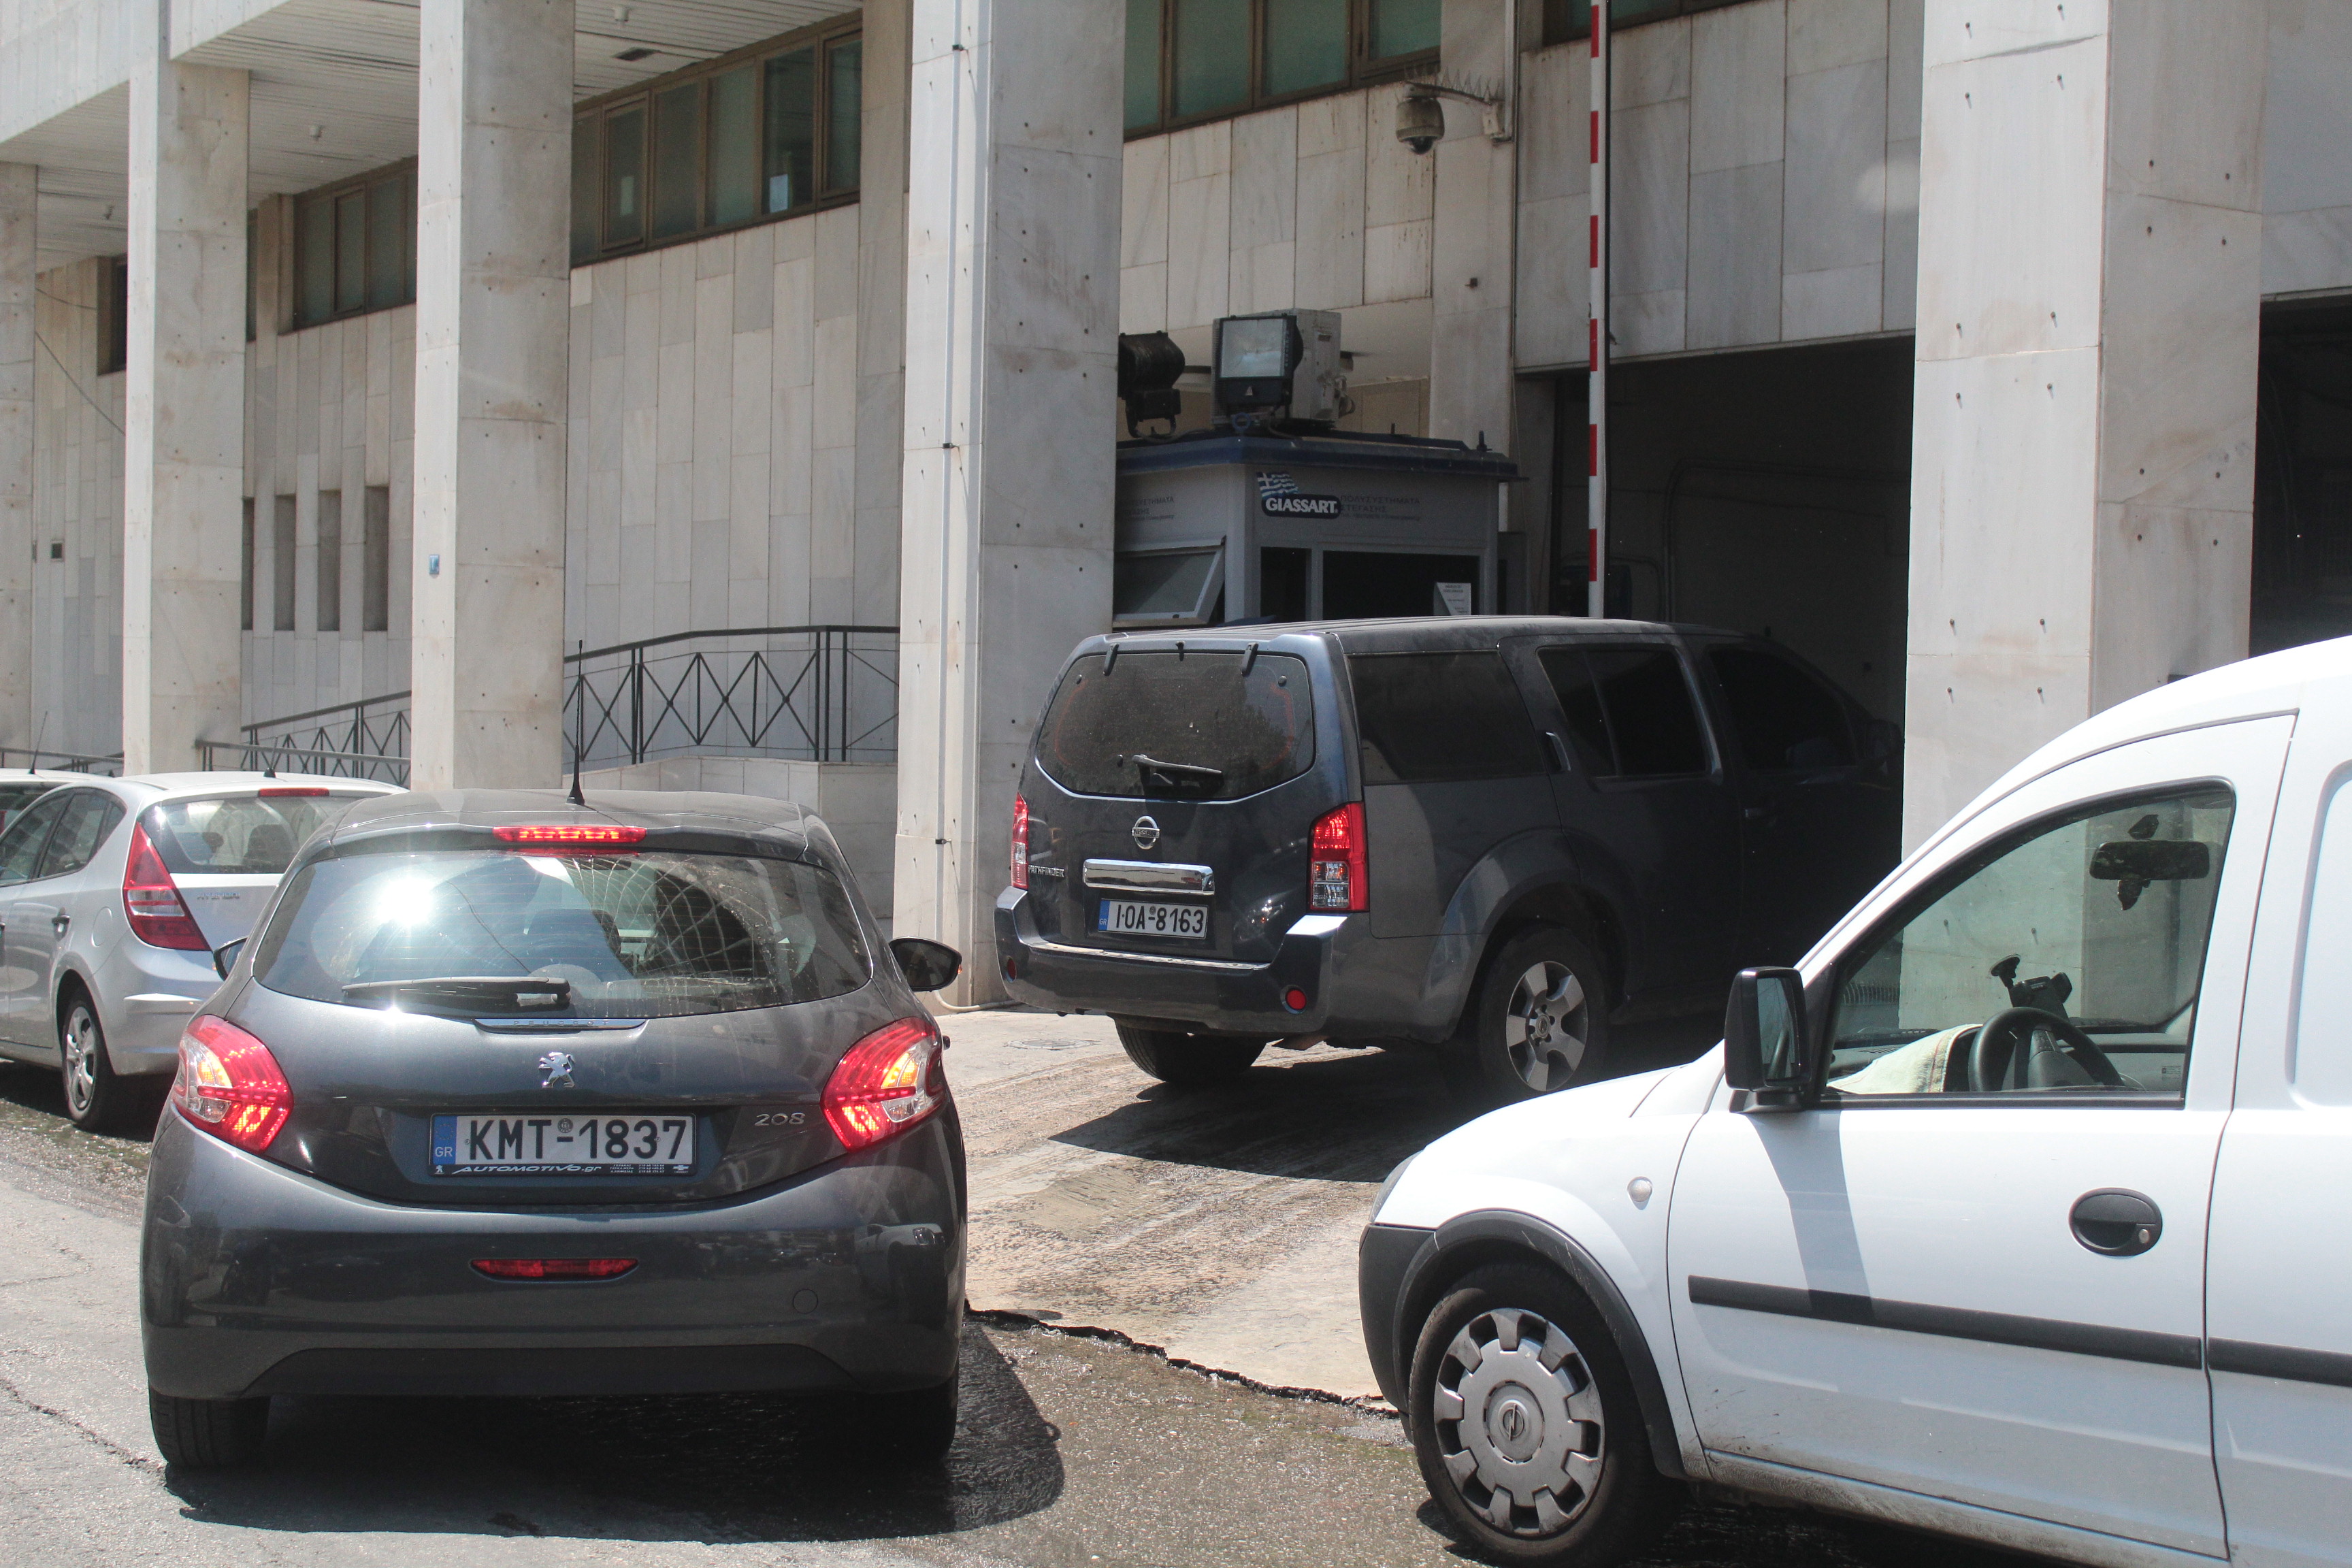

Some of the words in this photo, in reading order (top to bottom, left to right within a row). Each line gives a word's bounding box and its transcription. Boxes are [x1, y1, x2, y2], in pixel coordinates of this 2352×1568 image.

[1265, 497, 1337, 514] GIASSART
[1133, 829, 1158, 838] NISSAN
[1028, 864, 1065, 878] PATHFINDER
[754, 1112, 806, 1126] 208
[469, 1119, 687, 1160] KMT-1837
[434, 1146, 453, 1158] GR
[452, 1164, 602, 1174] AUTOMOTIVO.gr
